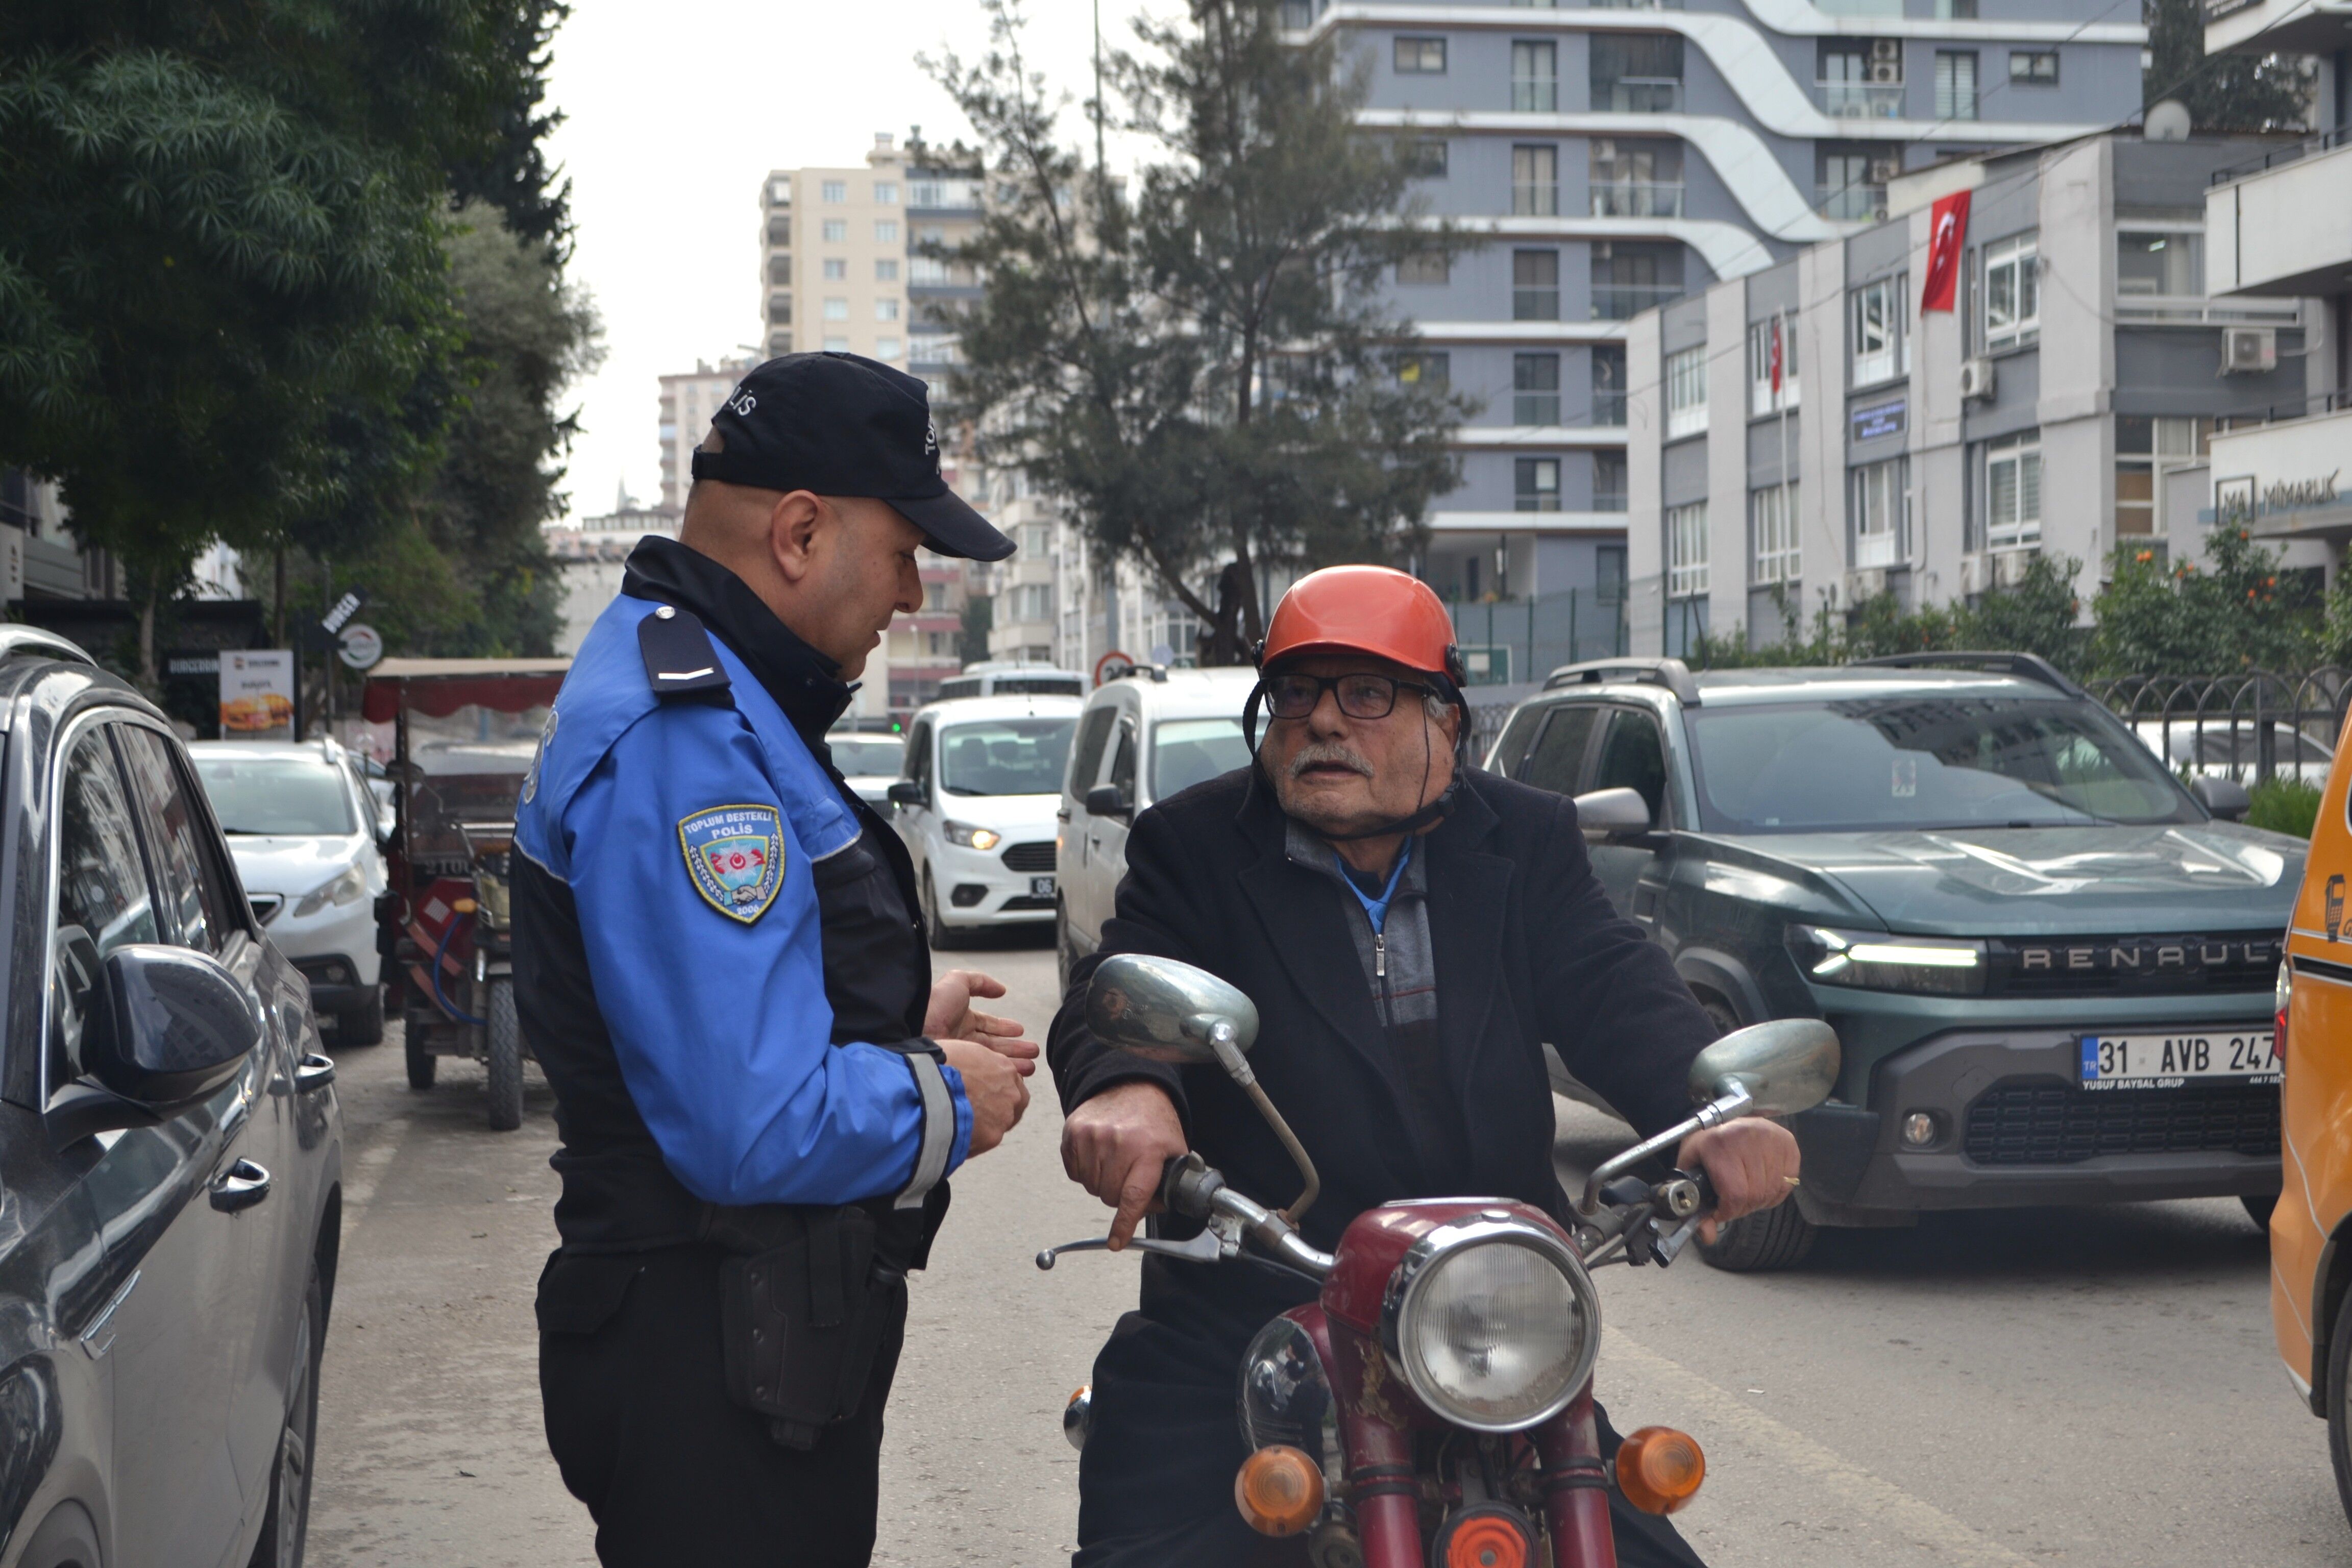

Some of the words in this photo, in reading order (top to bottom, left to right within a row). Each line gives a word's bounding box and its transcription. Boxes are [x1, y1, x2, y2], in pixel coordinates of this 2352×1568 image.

[684, 815, 724, 834] TOPLUM
[726, 811, 772, 823] DESTEKLİ
[711, 822, 753, 839] POLİS
[737, 904, 759, 915] 2006
[2023, 942, 2283, 969] RENAUL
[2083, 1061, 2097, 1071] TR
[2099, 1041, 2127, 1073] 31
[2161, 1038, 2210, 1072] AVB
[2230, 1036, 2275, 1070] 247
[2082, 1079, 2116, 1090] YUSUF
[2117, 1079, 2155, 1089] BAYSAL
[2157, 1077, 2185, 1088] GRUP
